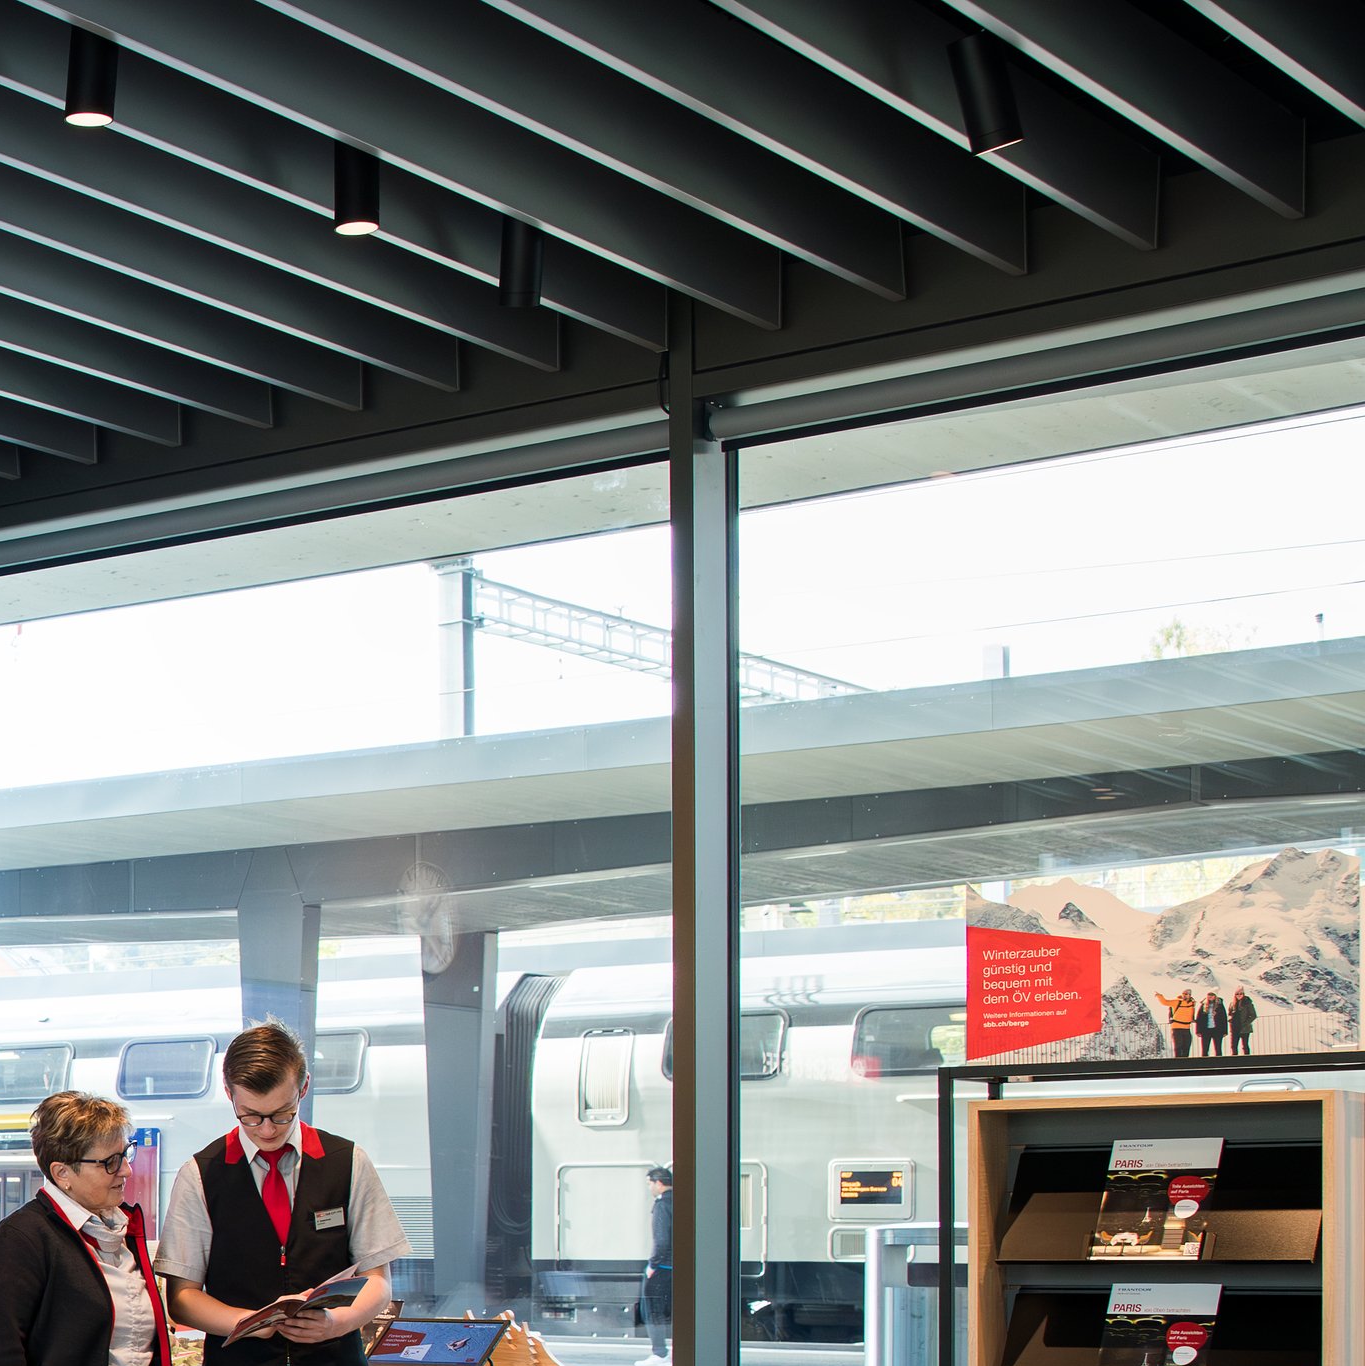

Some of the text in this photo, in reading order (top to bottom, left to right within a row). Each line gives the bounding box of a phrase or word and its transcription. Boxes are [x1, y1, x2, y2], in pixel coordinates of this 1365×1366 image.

[983, 947, 1061, 960] Winterzauber
[983, 961, 1052, 977] günstig und
[983, 976, 1053, 991] bequem mit
[983, 990, 1082, 1004] dem ÖV erleben.
[983, 1020, 1029, 1028] sbb.ch/berge
[1114, 1160, 1144, 1169] PARIS
[1112, 1303, 1142, 1313] PARIS
